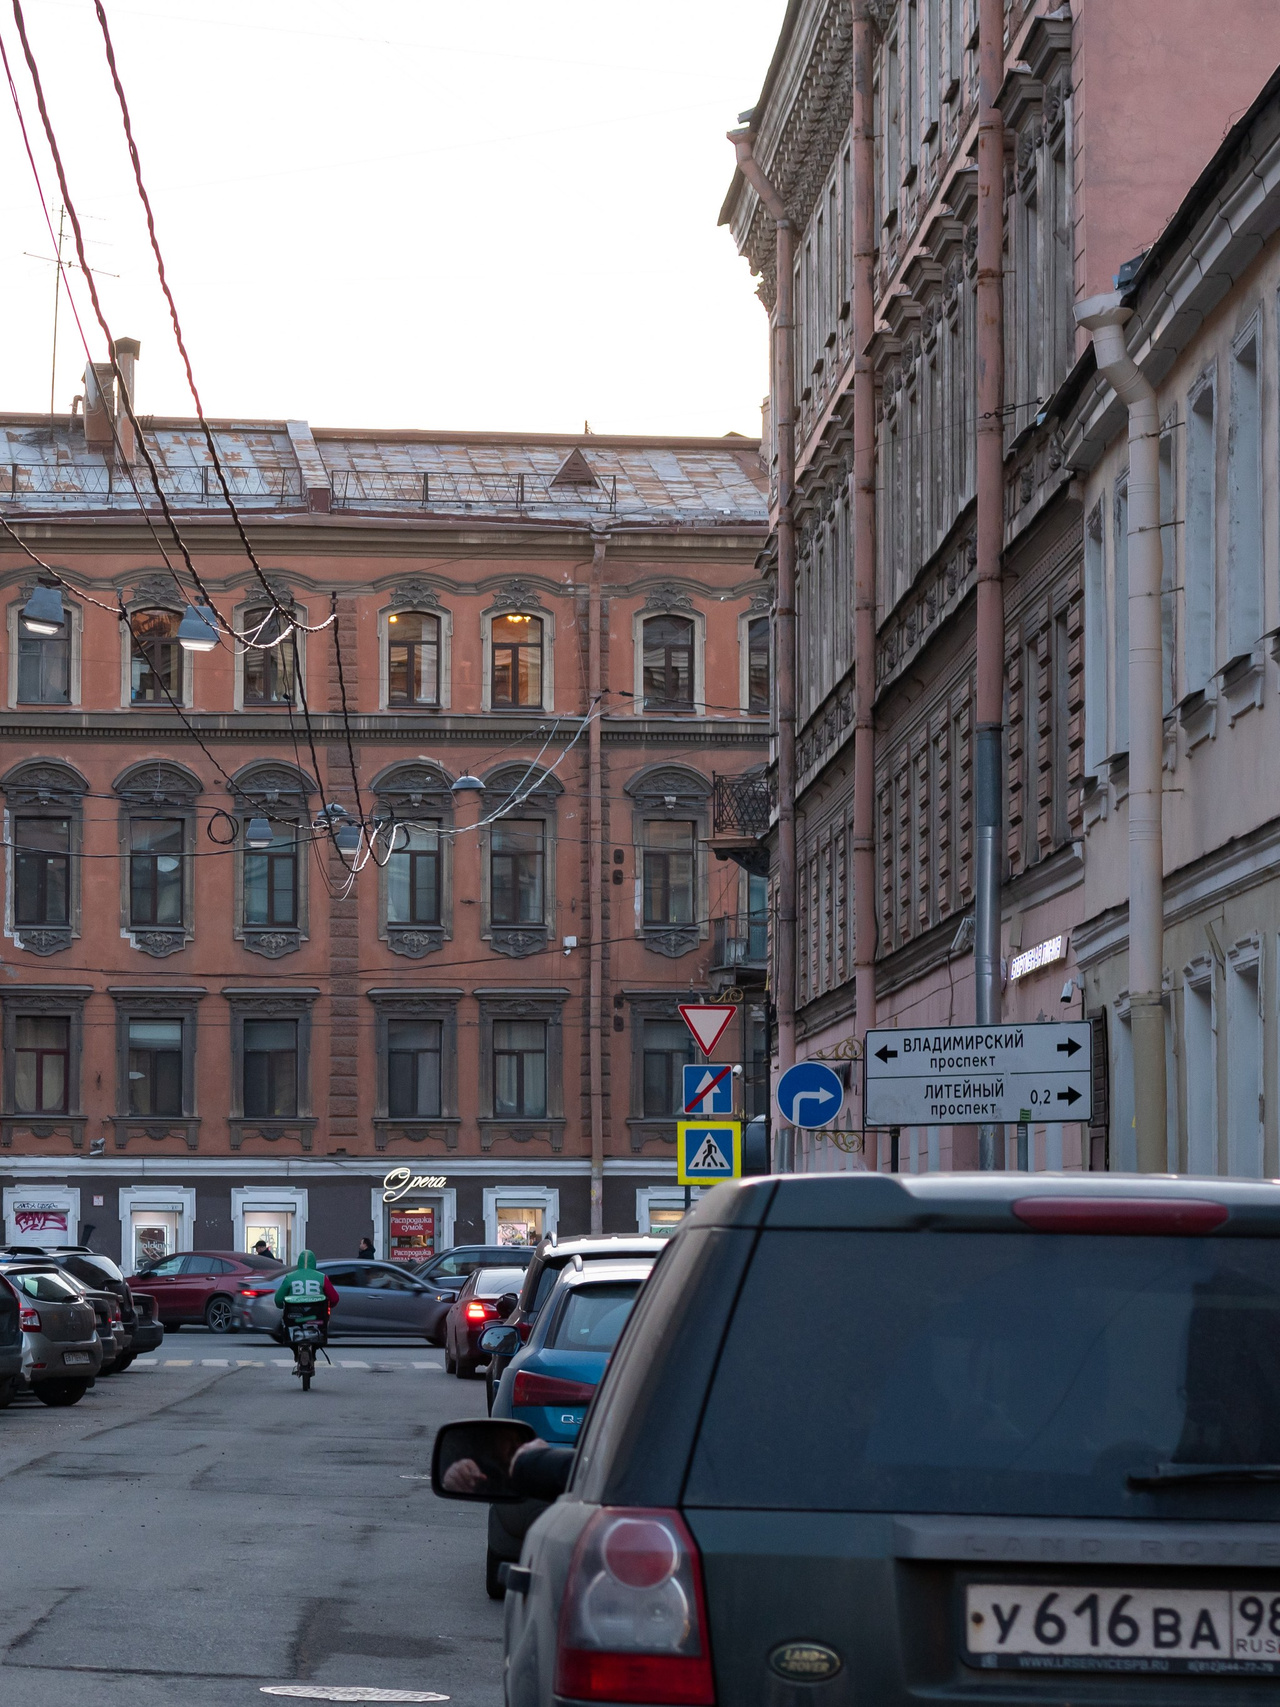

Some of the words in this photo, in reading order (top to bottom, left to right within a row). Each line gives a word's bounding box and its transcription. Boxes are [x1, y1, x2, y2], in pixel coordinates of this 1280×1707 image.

[903, 1029, 1024, 1053] ВЛАДИМИРСКИЙ
[930, 1055, 996, 1072] проспект
[924, 1079, 1004, 1099] ЛИТЕЙНЫЙ
[1030, 1089, 1051, 1105] 0,2
[930, 1102, 996, 1118] проспект
[382, 1167, 447, 1203] Opera
[391, 1216, 432, 1225] Распродажа
[401, 1224, 424, 1232] сумок
[964, 1536, 1105, 1556] LAND
[991, 1592, 1221, 1650] У616ВА
[1236, 1639, 1276, 1653] RUS
